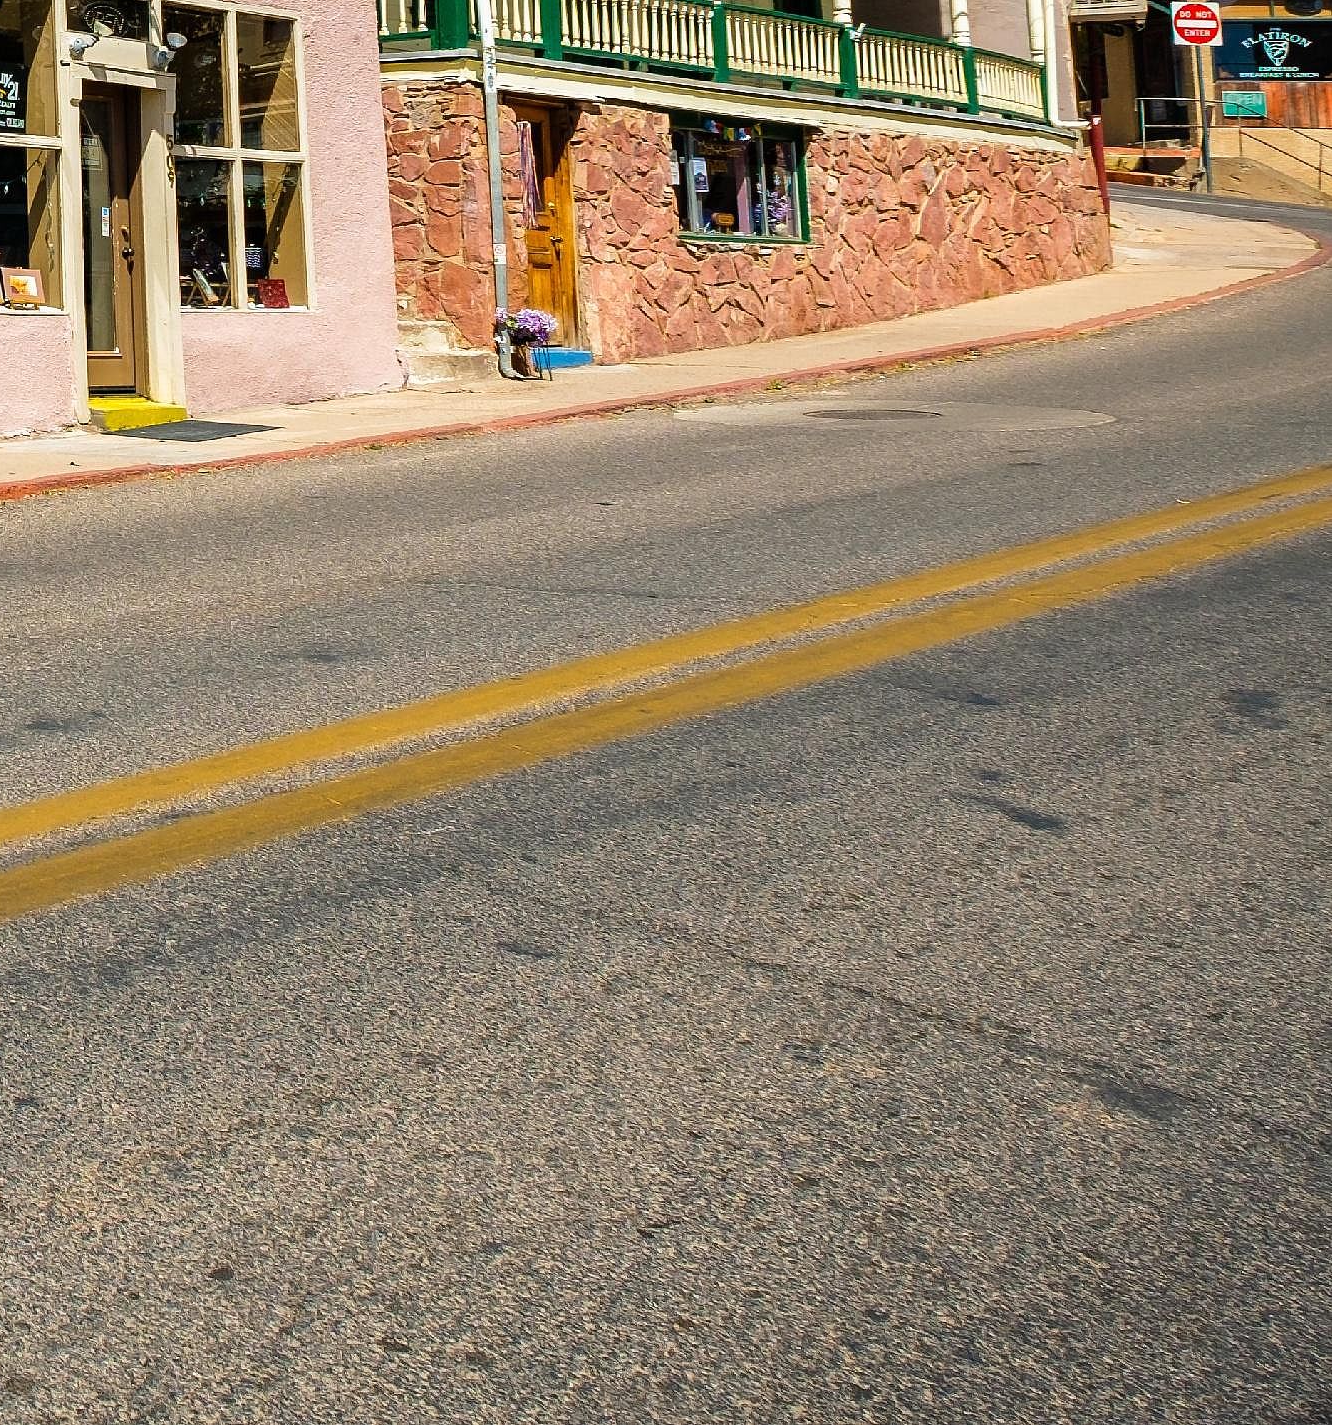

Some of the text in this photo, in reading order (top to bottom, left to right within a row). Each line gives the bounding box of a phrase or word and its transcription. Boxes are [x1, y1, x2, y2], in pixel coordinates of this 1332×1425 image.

[1180, 10, 1213, 19] DO NOT
[1184, 29, 1211, 37] ENTER
[1241, 31, 1313, 49] FLATIRON
